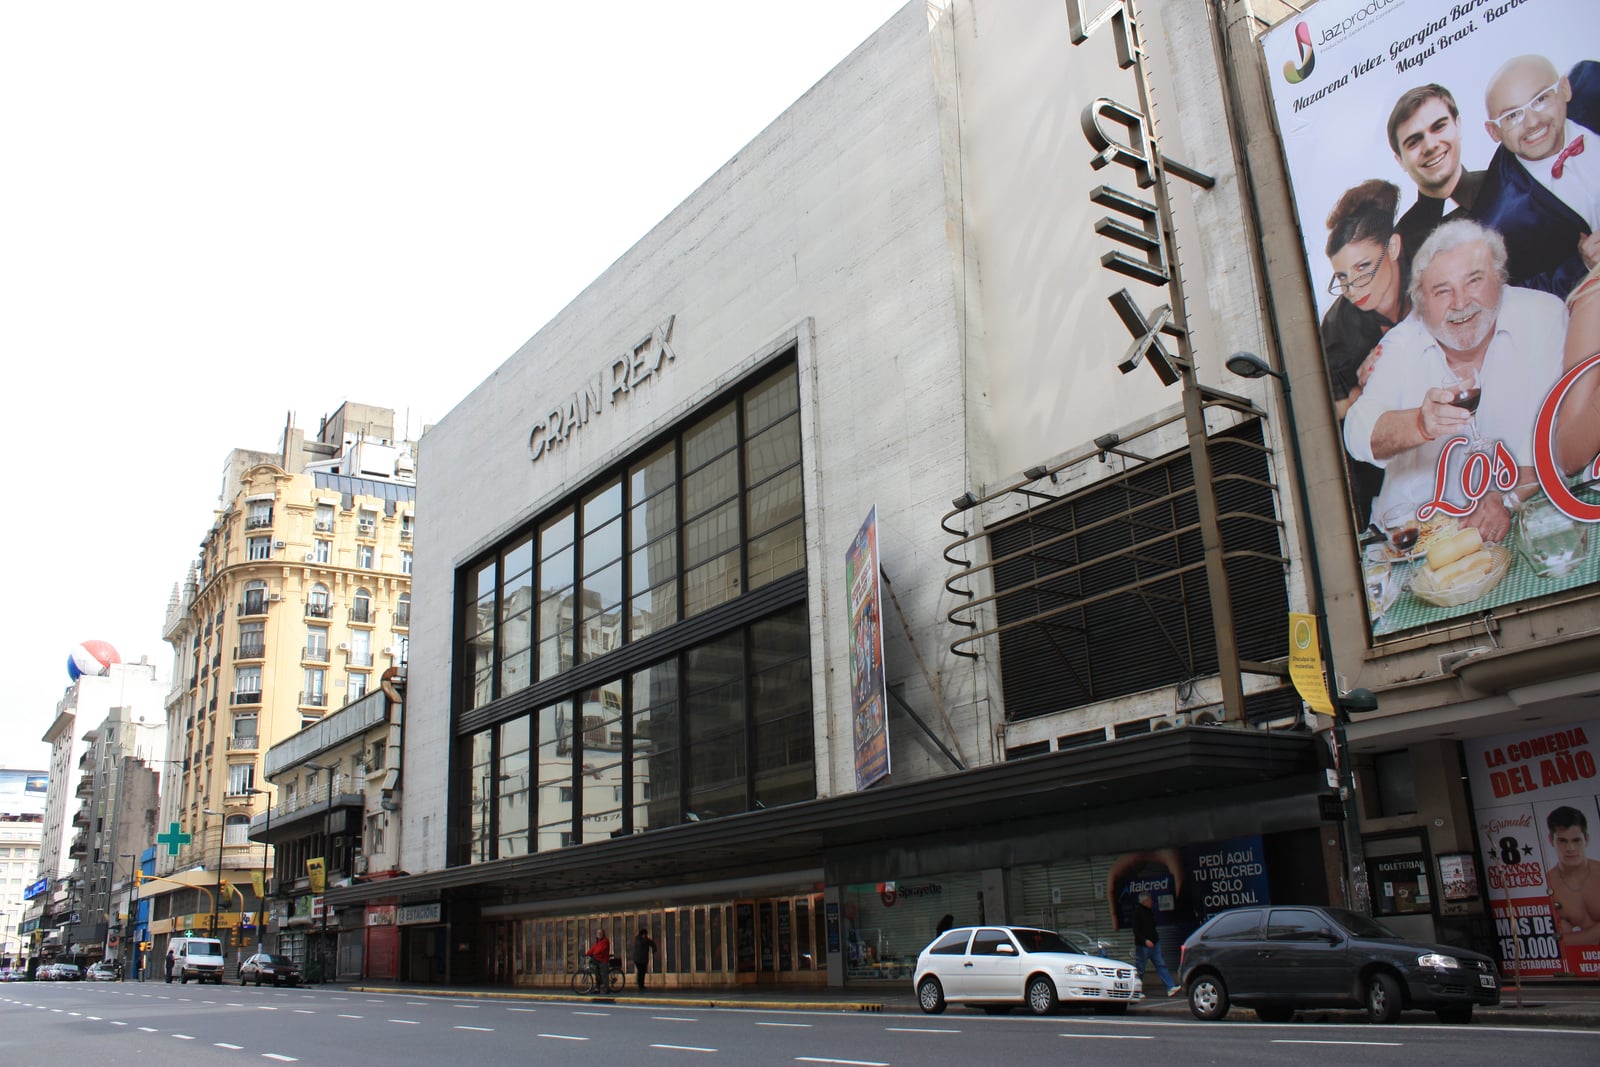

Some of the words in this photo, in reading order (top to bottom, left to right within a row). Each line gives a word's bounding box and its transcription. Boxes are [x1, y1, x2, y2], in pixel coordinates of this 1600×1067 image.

[1318, 0, 1394, 45] Jazprodu
[1396, 43, 1436, 75] Magui
[1437, 21, 1478, 50] Bravi.
[1293, 73, 1348, 113] Nazarena
[1350, 54, 1386, 79] Velez.
[1389, 17, 1447, 61] Georgina
[527, 371, 603, 461] GRAN
[610, 315, 676, 403] REX
[1417, 437, 1518, 522] Los
[1484, 748, 1507, 768] LA
[1507, 727, 1589, 762] COMEDIA
[1489, 767, 1538, 798] DEL
[1541, 750, 1597, 787] AÑO
[1199, 850, 1224, 867] PEDÍ
[1226, 847, 1253, 864] AQUÍ
[1499, 836, 1521, 864] 8
[1193, 869, 1207, 881] TU
[1209, 863, 1263, 879] ITALCRED
[899, 883, 943, 898] Sprayette
[1129, 877, 1169, 893] italcred
[1211, 878, 1243, 893] SÓLO
[1204, 894, 1229, 907] CON
[1494, 907, 1505, 918] YA
[1517, 904, 1551, 917] VIERON
[1532, 916, 1555, 935] DE
[1499, 936, 1559, 960] 150.000
